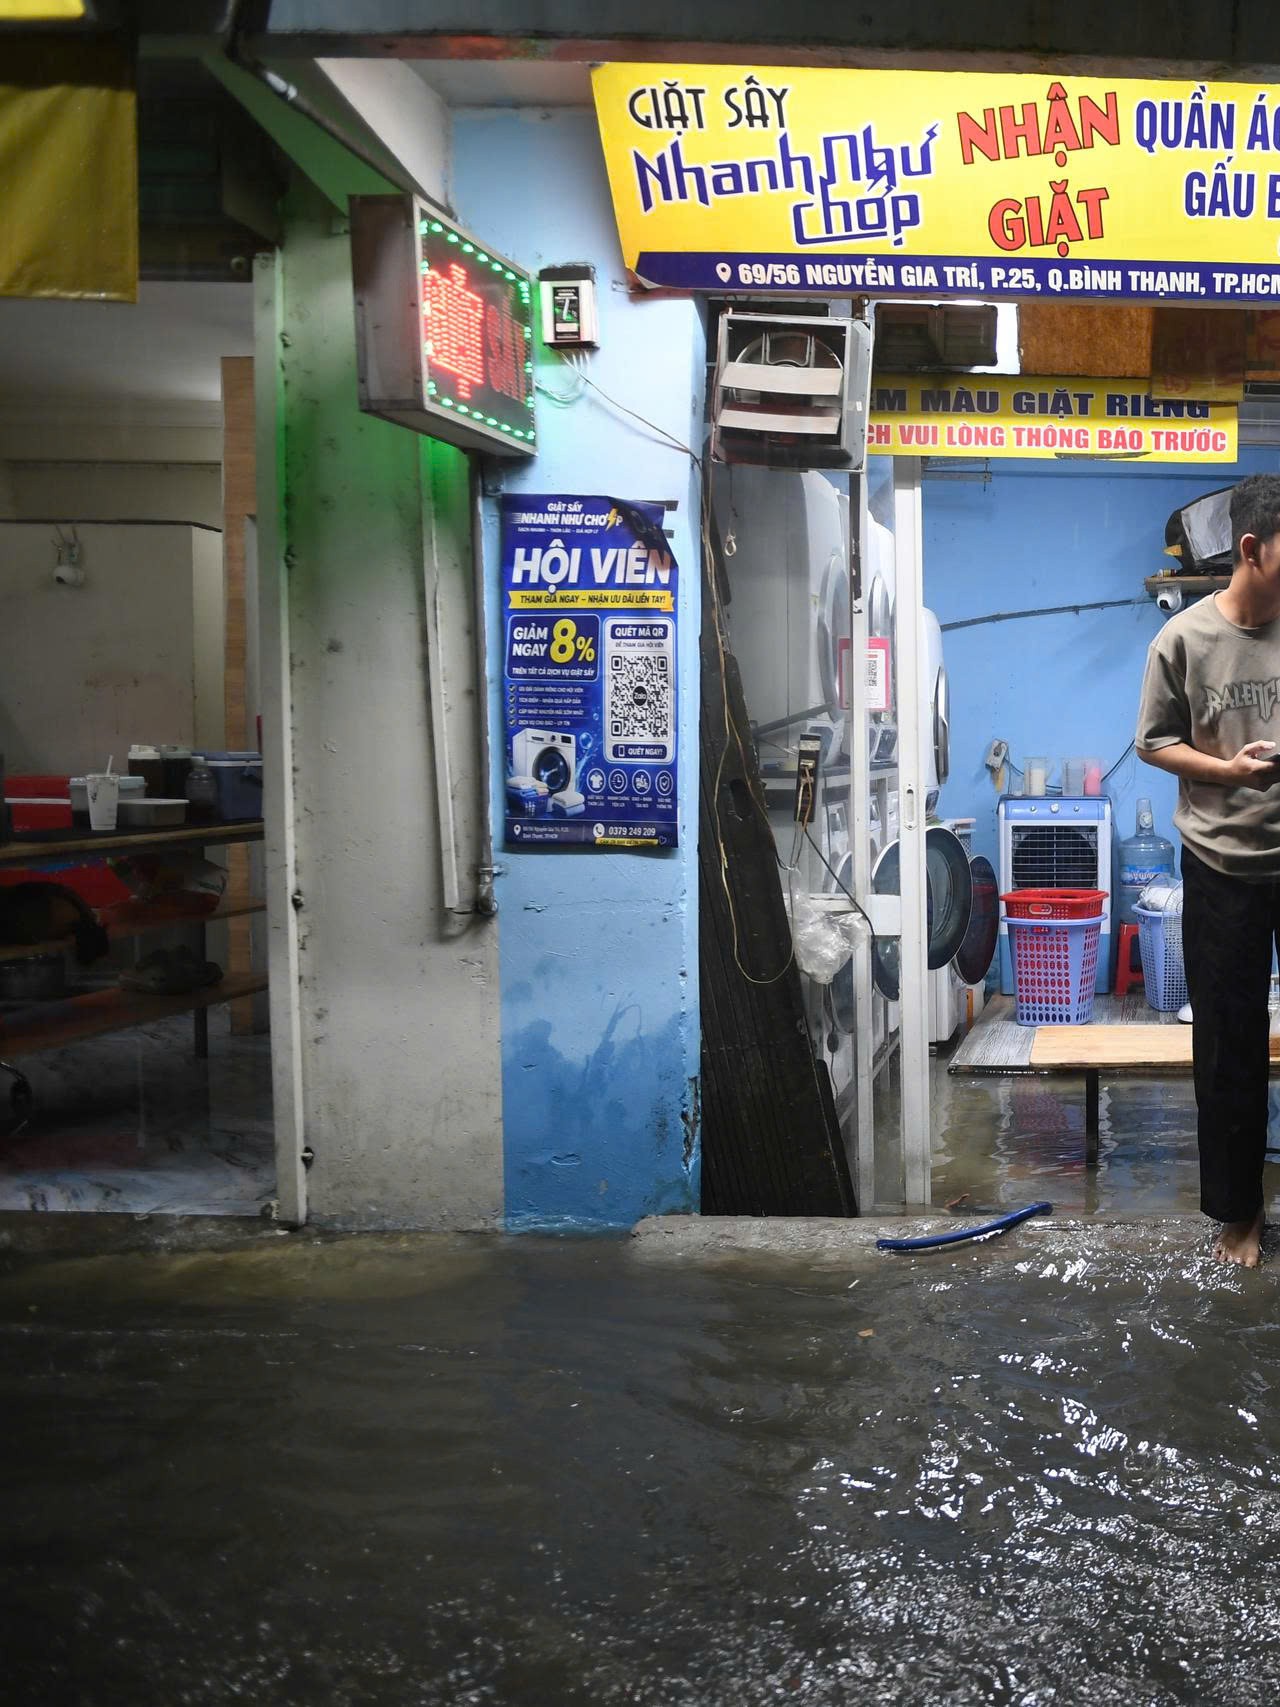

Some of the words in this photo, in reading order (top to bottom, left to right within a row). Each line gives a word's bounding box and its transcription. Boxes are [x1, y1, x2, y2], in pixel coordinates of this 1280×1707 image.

[629, 82, 704, 136] GIẶT
[725, 77, 788, 130] SẤY
[1135, 84, 1234, 154] QUẦN
[956, 81, 1121, 167] NHẬN
[633, 132, 815, 213] Nhanh
[1184, 150, 1256, 219] GẤU
[987, 179, 1110, 257] GIẶT
[738, 263, 801, 285] 69/56
[807, 257, 895, 286] NGUYỄN
[900, 265, 939, 287] GIA
[943, 263, 985, 290] TRÍ,
[991, 267, 1041, 291] P.25,
[1049, 265, 1121, 292] Q.BÌNH
[1128, 270, 1206, 296] THẠNH,
[921, 386, 999, 414] MÀU
[1012, 388, 1093, 420] GIẶT
[900, 425, 938, 445] VUI
[947, 423, 1003, 447] LÒNG
[1012, 420, 1089, 449] THÔNG
[1098, 425, 1142, 450] BÁO
[1151, 427, 1226, 452] TRƯỚC
[520, 513, 560, 524] NHANH
[561, 513, 584, 525] NHƯ
[547, 502, 566, 513] GIẶT
[567, 501, 583, 512] SẤY
[512, 539, 581, 594] HỘI
[590, 540, 672, 584] VIÊN
[520, 595, 545, 604] THAM
[546, 595, 558, 604] GIA
[559, 595, 579, 604] NGAY
[588, 594, 609, 604] NHẬN
[622, 594, 635, 604] ĐÃI
[513, 623, 549, 640] GIẢM
[550, 618, 595, 663] 8%
[615, 626, 637, 637] QUÉT
[639, 626, 651, 636] MÃ
[652, 627, 664, 637] QR
[512, 643, 547, 657] NGAY
[628, 747, 644, 755] QUÉT
[608, 826, 628, 835] 0379
[628, 827, 642, 835] 249
[643, 828, 656, 836] 209
